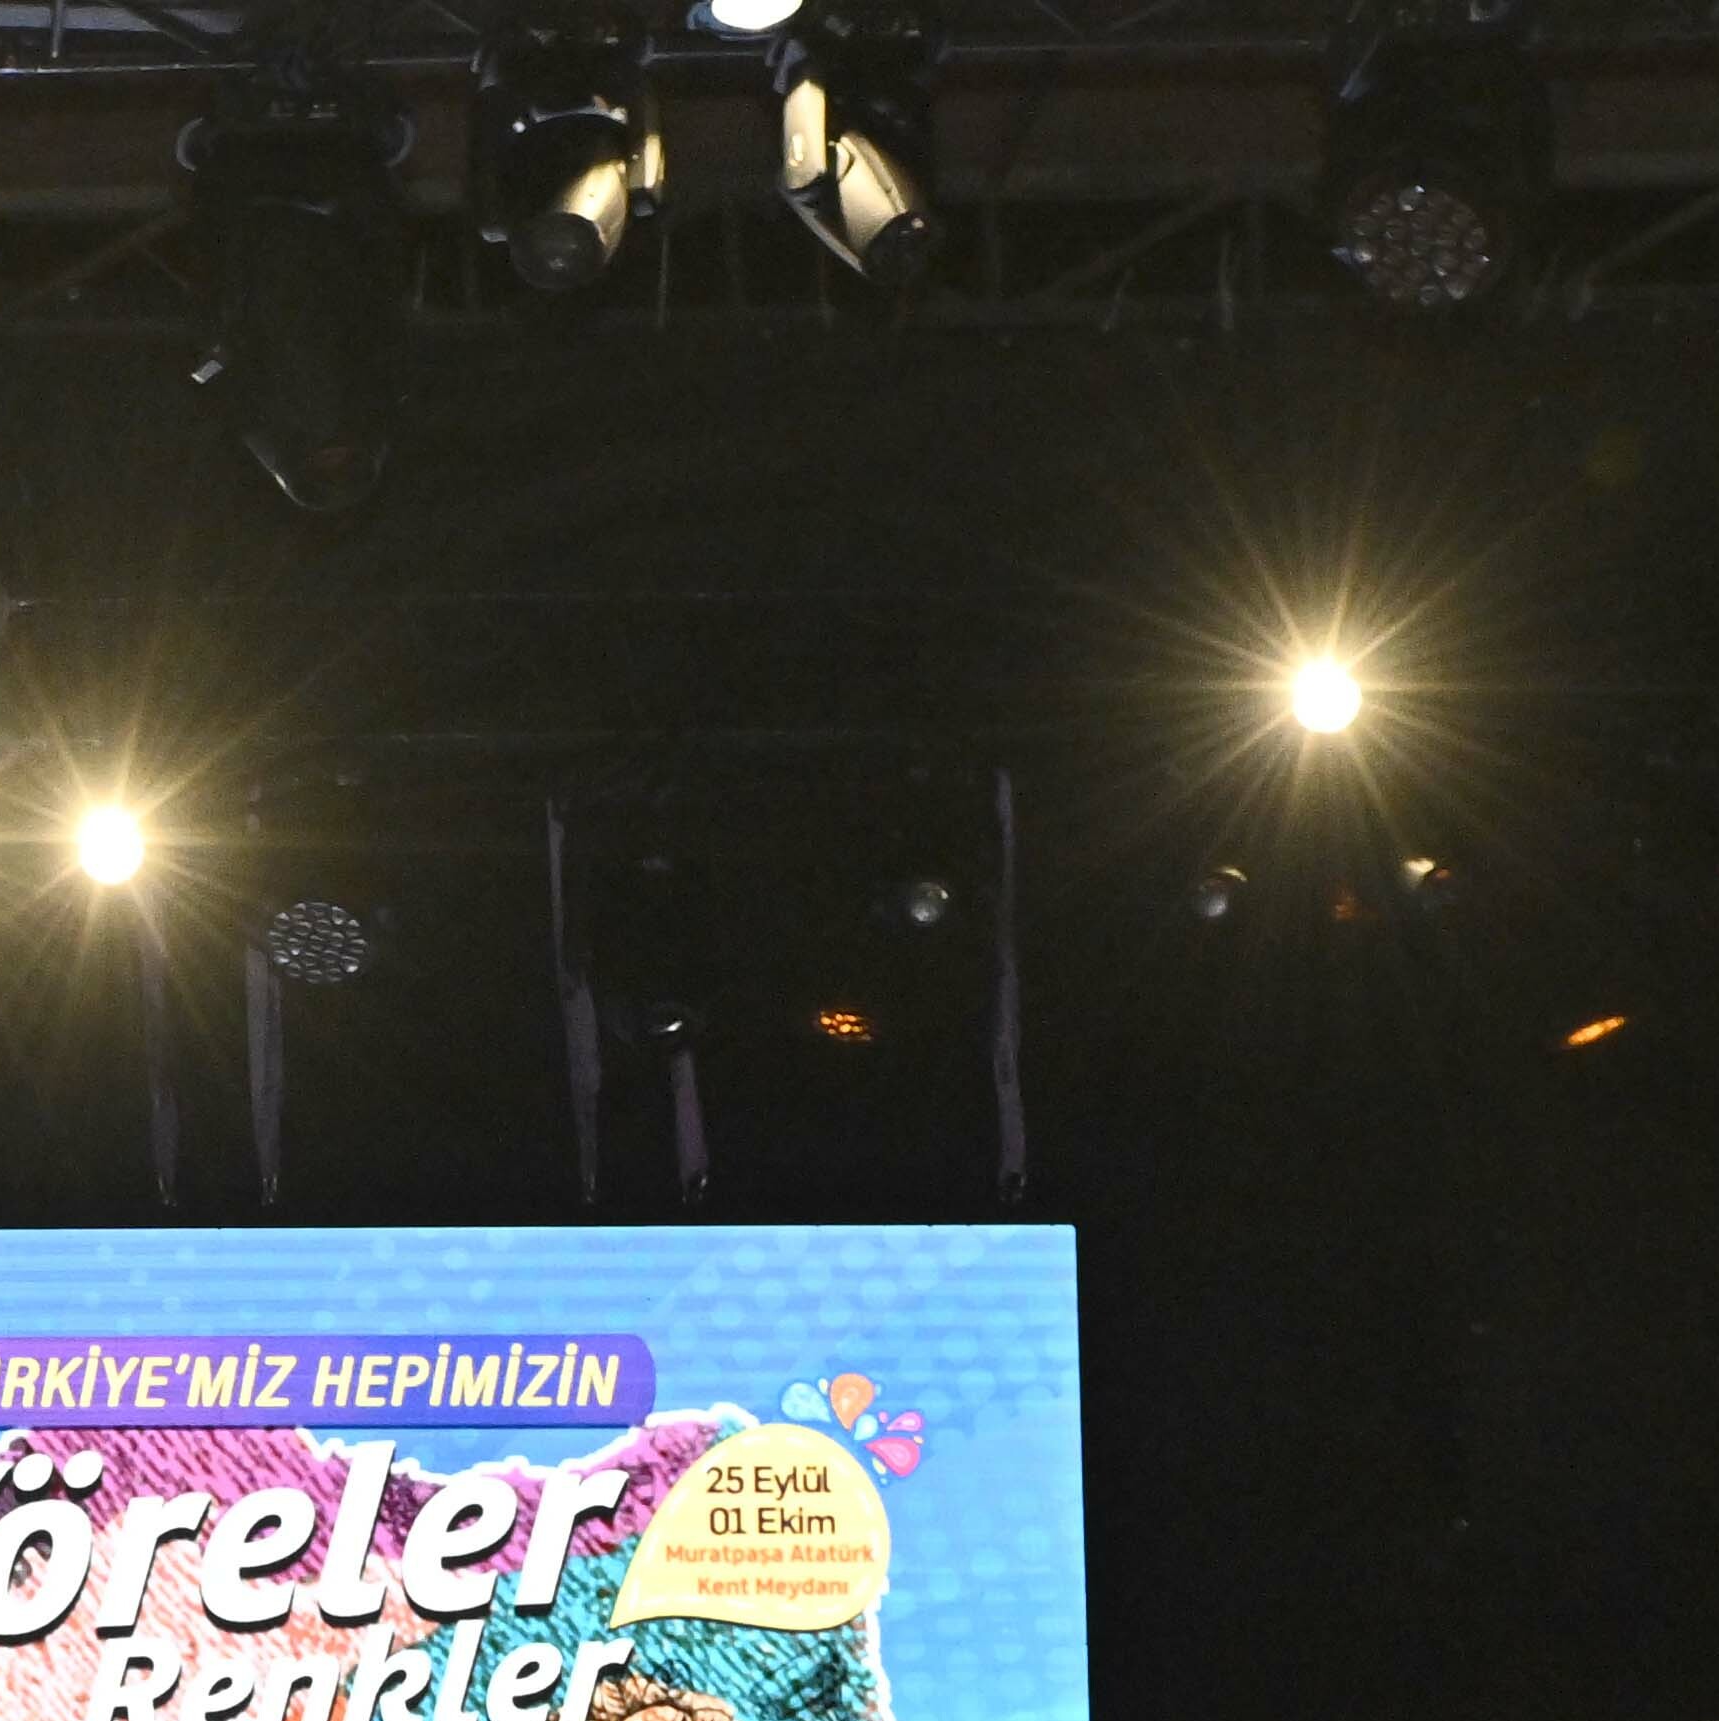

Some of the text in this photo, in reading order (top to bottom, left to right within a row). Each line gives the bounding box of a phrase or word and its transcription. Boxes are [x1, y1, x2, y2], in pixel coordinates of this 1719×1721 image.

[311, 1343, 619, 1407] HEPİMİZİN
[706, 1466, 831, 1501] 25 Eylül
[709, 1507, 836, 1535] 01 Ekim
[665, 1545, 874, 1565] Muratpaşa Atatürk
[697, 1577, 849, 1601] Kent Meydanı
